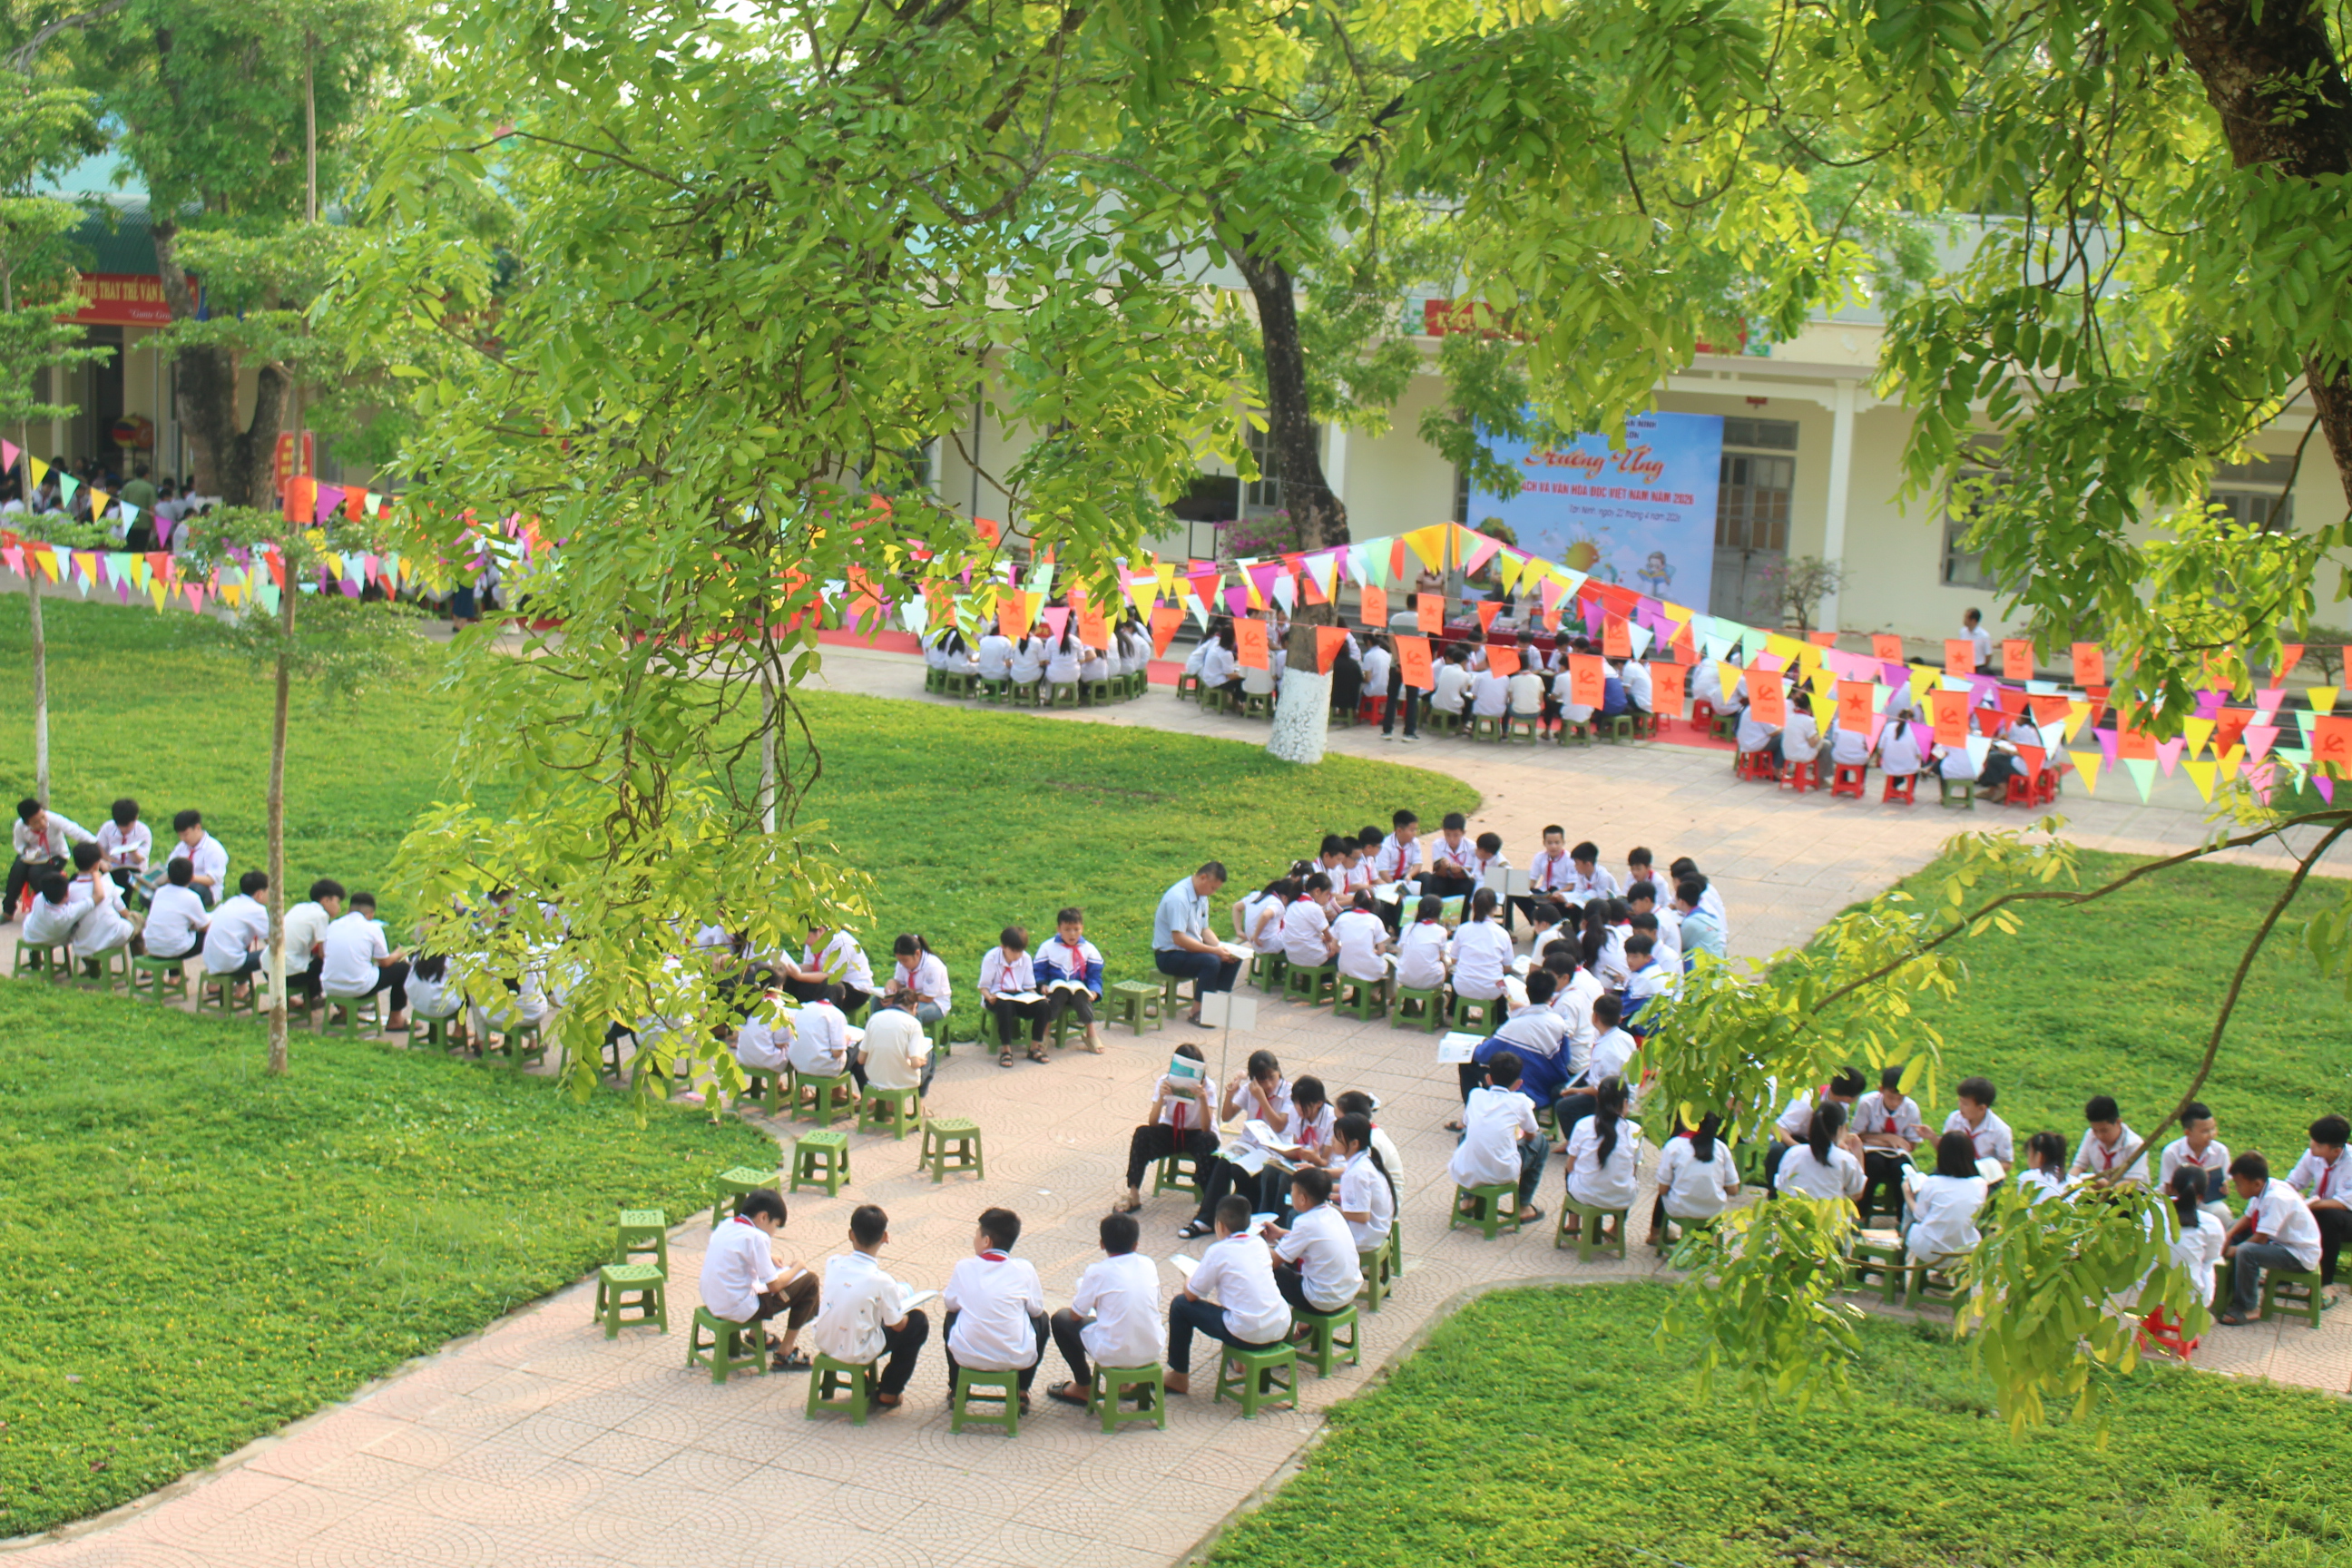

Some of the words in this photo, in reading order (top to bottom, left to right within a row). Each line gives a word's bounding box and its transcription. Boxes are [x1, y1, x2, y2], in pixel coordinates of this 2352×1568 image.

[99, 282, 121, 300] THAY
[1638, 419, 1657, 428] NINH
[1591, 485, 1607, 498] ĐỌC
[1610, 486, 1626, 500] VIỆT
[1630, 490, 1649, 501] NAM
[1651, 489, 1671, 503] NĂM
